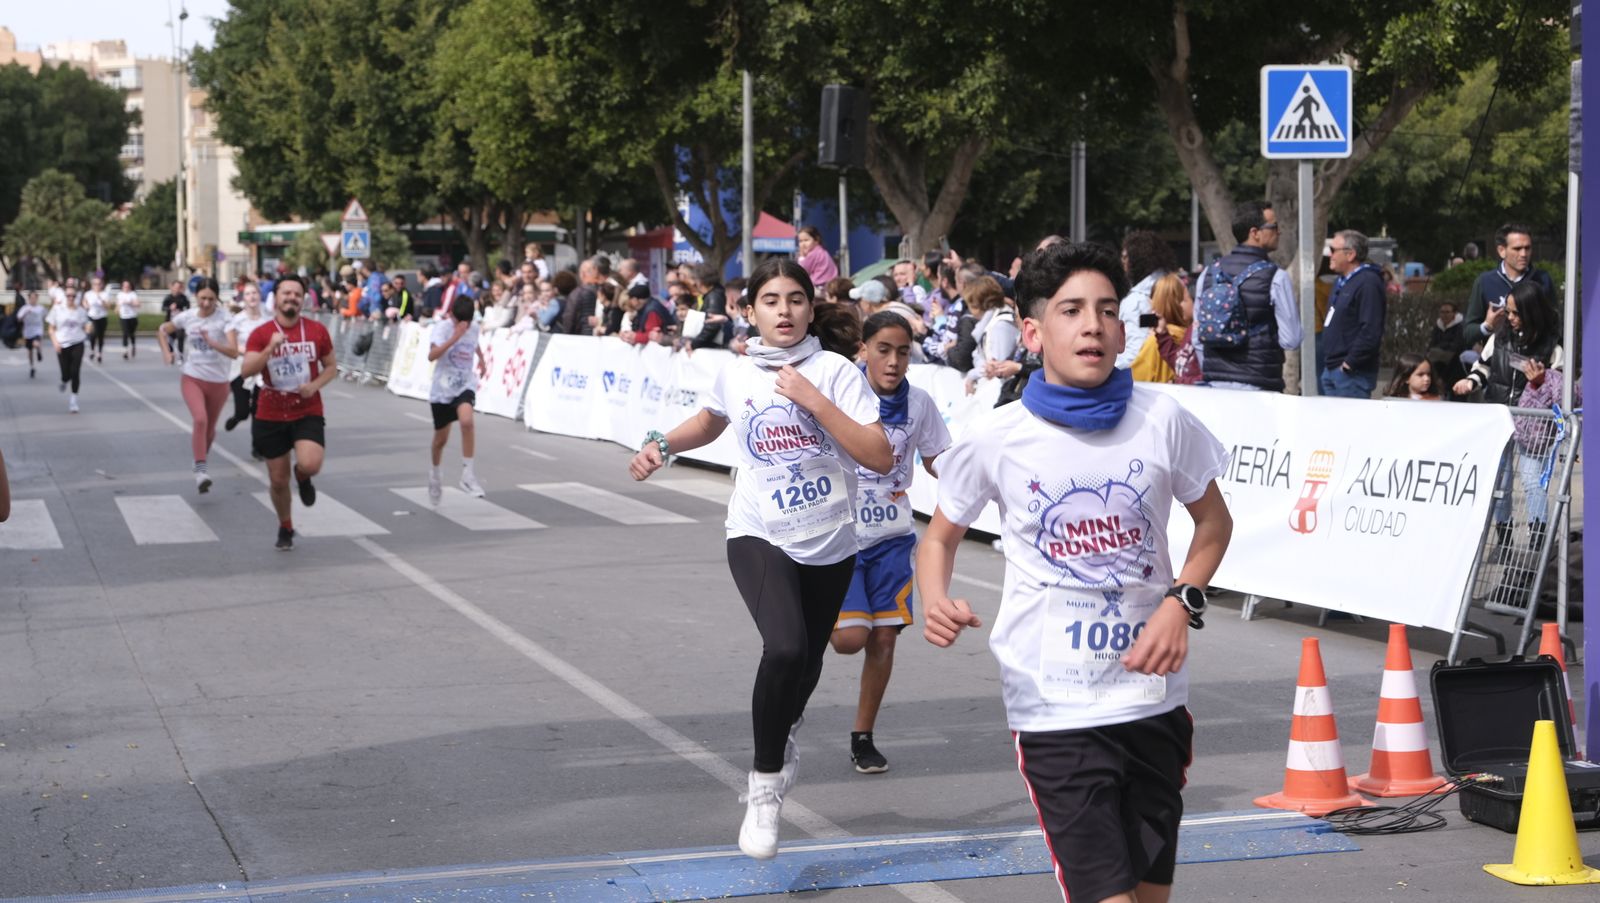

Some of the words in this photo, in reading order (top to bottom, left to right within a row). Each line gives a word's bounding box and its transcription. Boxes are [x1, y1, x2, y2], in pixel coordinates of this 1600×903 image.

[765, 424, 802, 439] MINI
[755, 435, 820, 455] RUNNER
[766, 474, 785, 482] MUJER
[1347, 452, 1478, 508] ALMERÍA
[771, 476, 832, 510] 1260
[781, 505, 798, 515] VIVA
[799, 504, 807, 512] MI
[808, 496, 829, 509] PADRE
[854, 504, 898, 524] 090
[1066, 514, 1120, 538] MINI
[1344, 504, 1407, 537] CIUDAD
[1048, 528, 1142, 560] RUNNER
[1066, 600, 1096, 609] MUJER
[1094, 652, 1121, 661] HUGO
